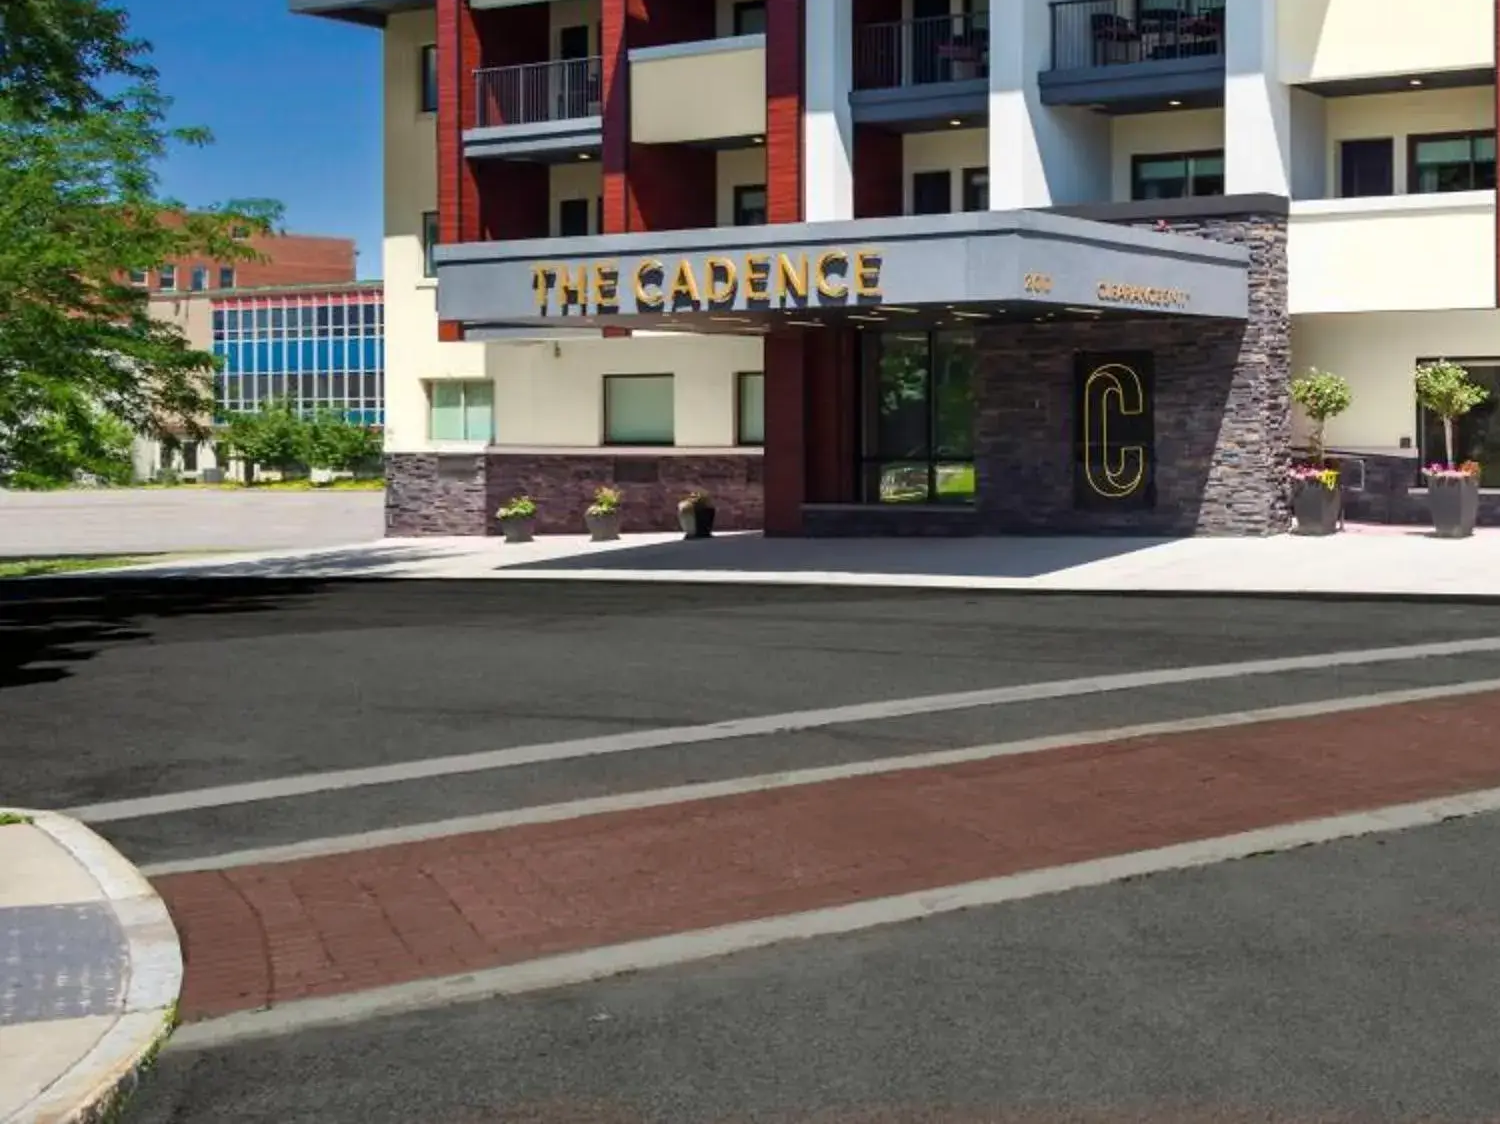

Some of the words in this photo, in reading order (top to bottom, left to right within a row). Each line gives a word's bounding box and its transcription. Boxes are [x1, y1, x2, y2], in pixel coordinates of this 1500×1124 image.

[532, 258, 620, 312] THE
[634, 248, 887, 312] CADENCE
[1084, 363, 1143, 497] C
